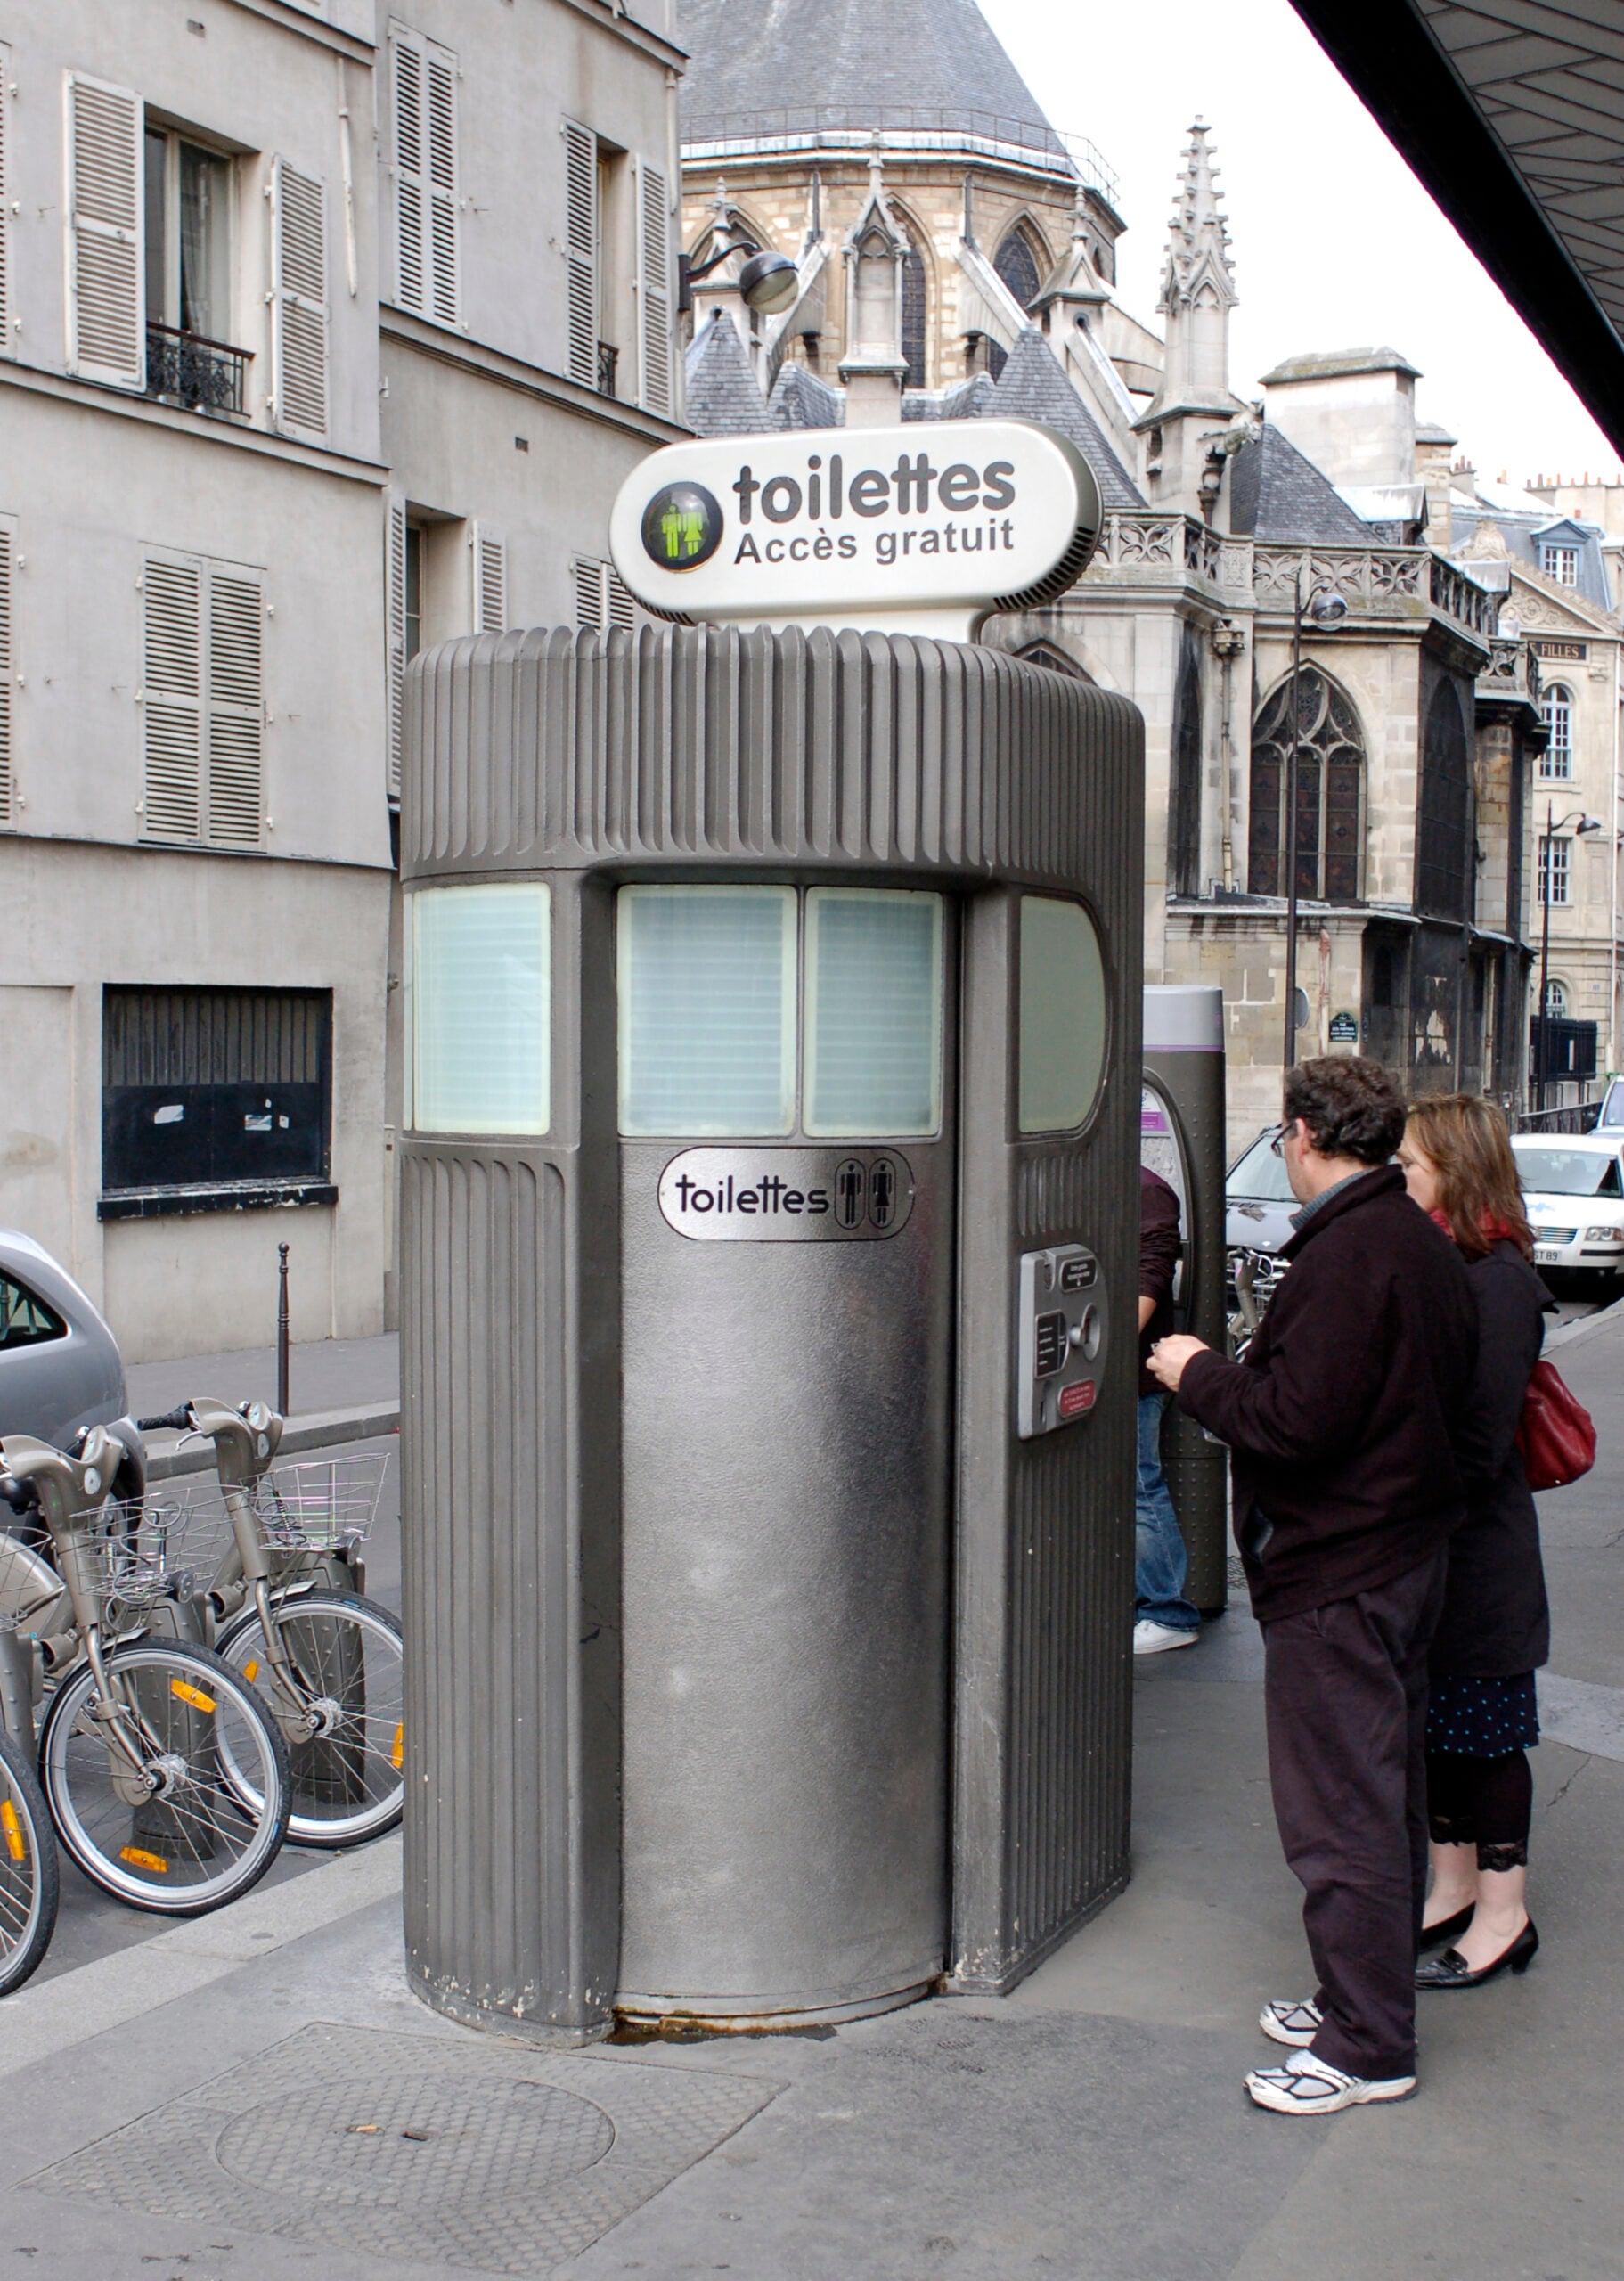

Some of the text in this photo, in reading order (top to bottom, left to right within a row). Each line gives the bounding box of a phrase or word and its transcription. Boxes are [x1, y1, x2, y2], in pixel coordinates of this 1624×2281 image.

[732, 453, 1016, 526] toilettes
[733, 518, 1016, 565] Accès gratuit
[1541, 643, 1579, 658] FILLES
[675, 1173, 830, 1214] toilettes
